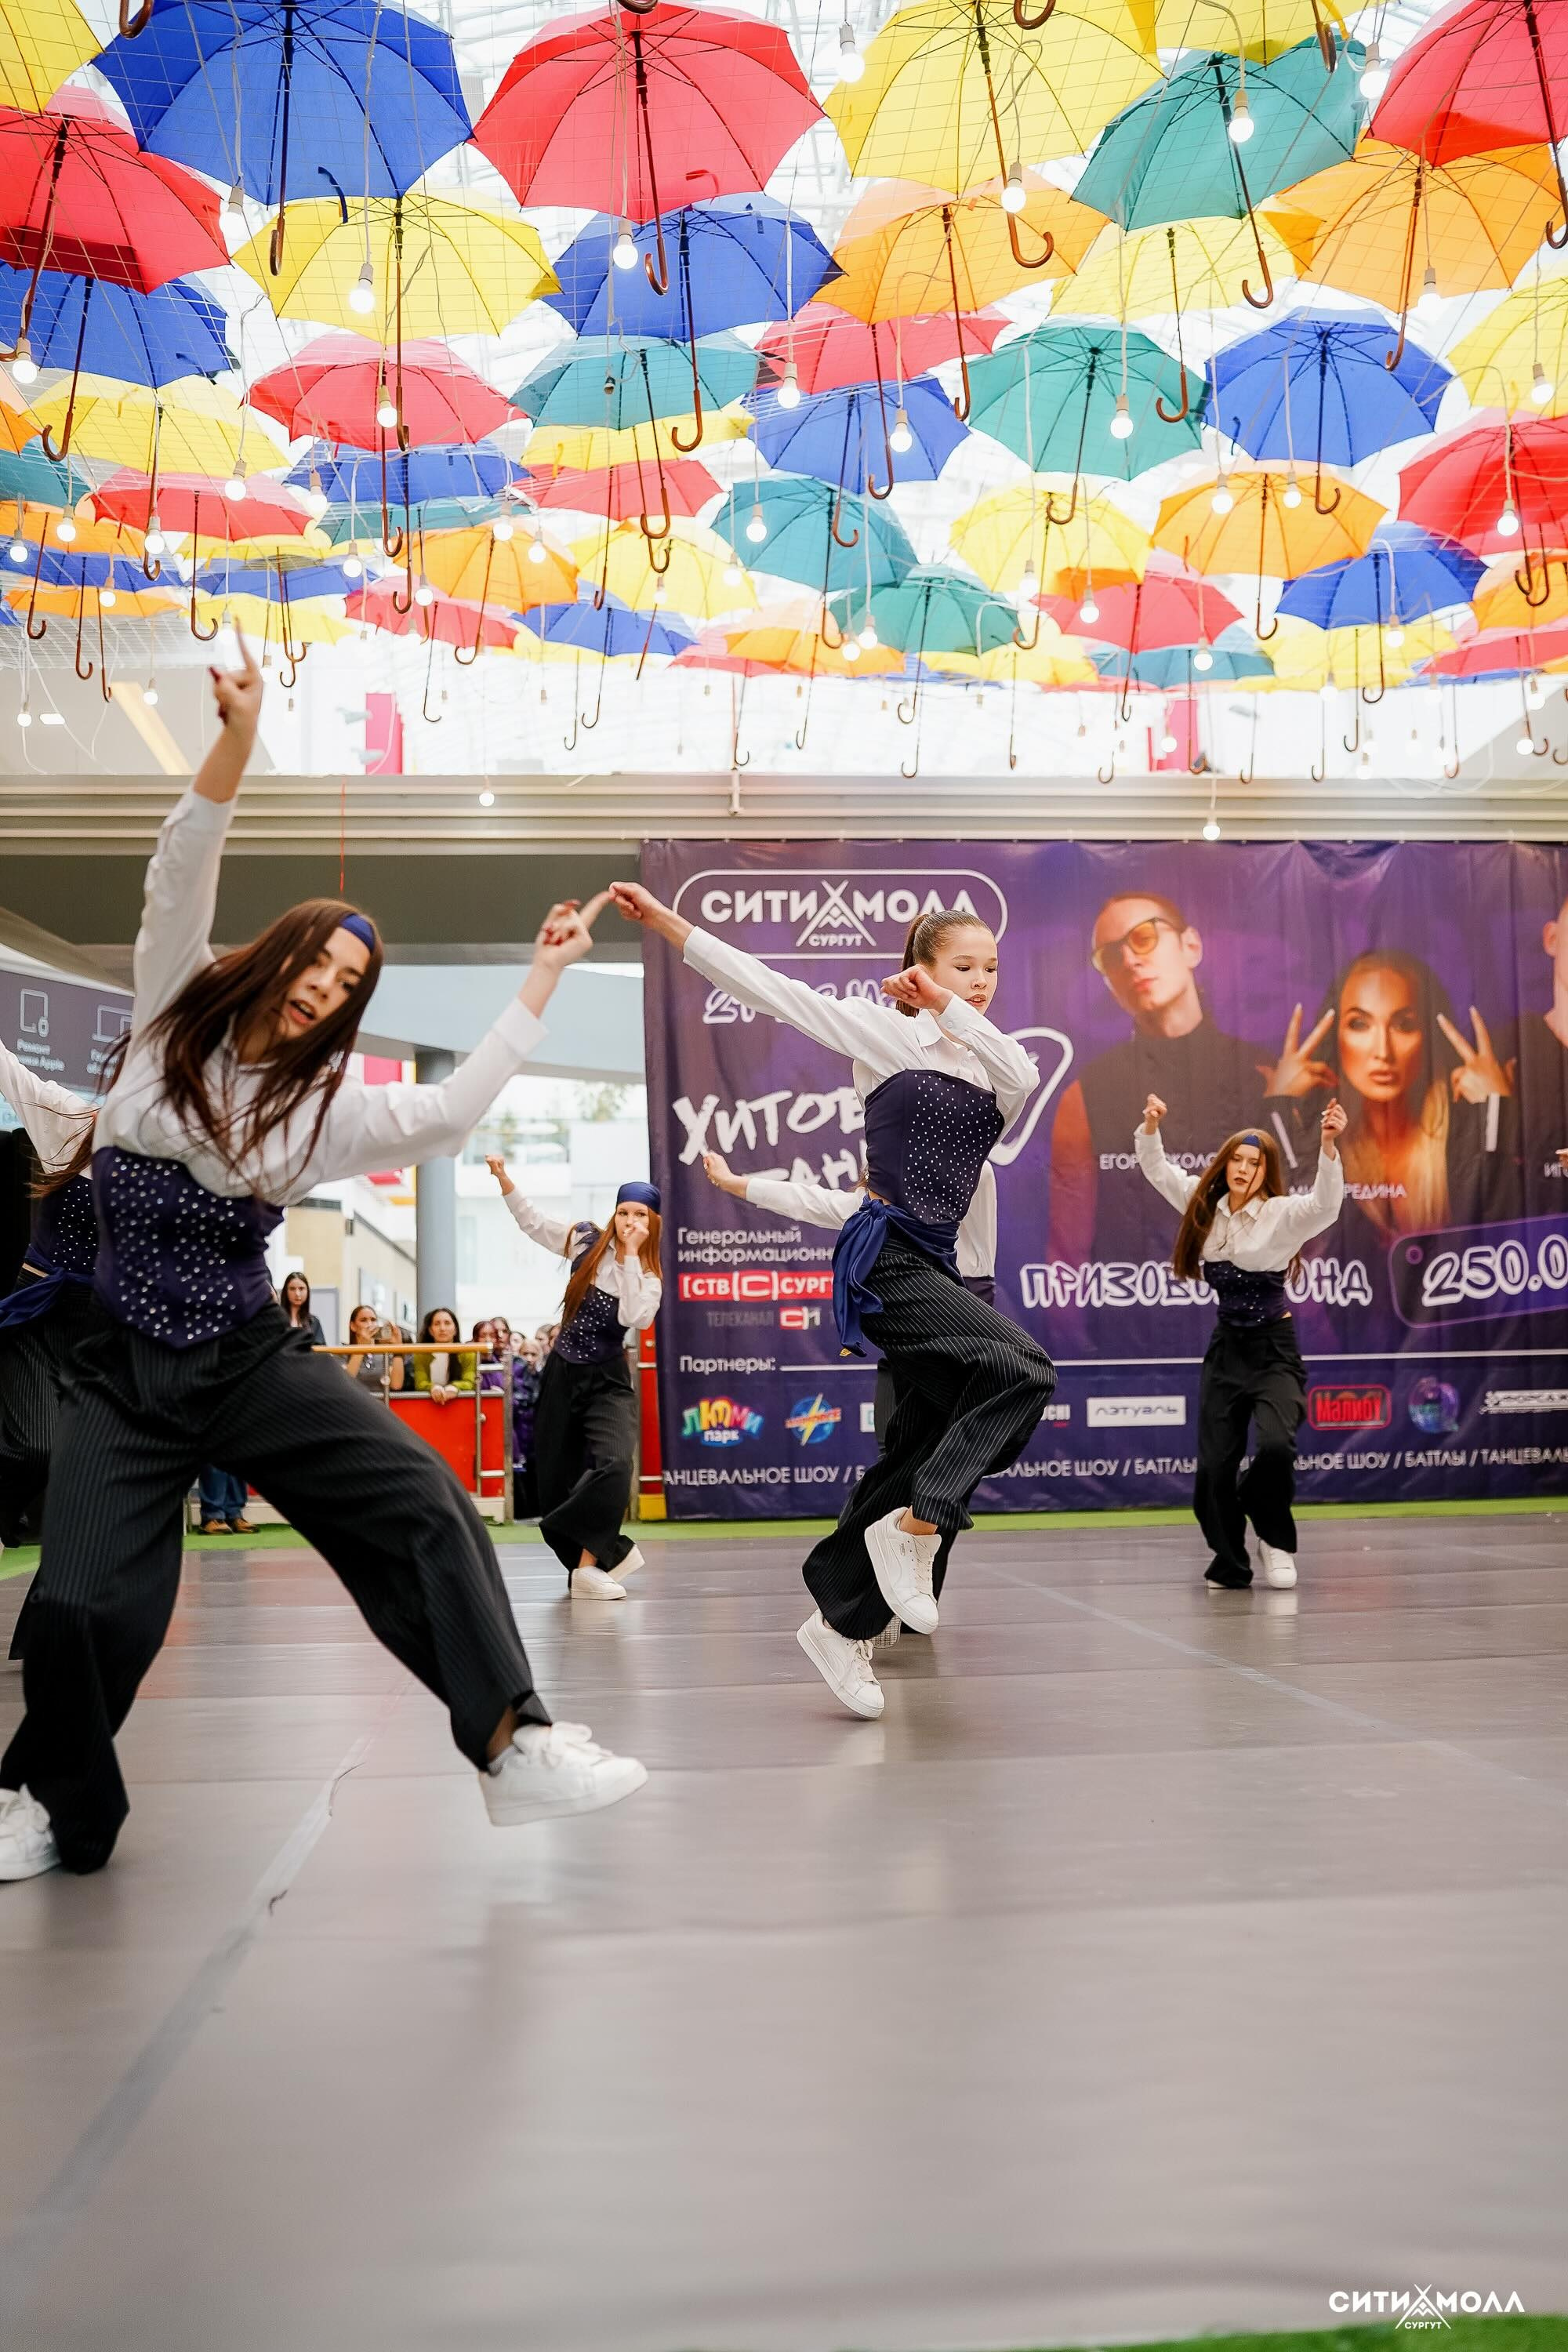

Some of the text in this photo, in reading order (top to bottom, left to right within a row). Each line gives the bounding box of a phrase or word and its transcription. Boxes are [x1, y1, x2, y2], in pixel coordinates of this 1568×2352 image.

[700, 889, 818, 924] СИТИ
[808, 934, 864, 947] СУРГУТ
[673, 1087, 866, 1166] ХИТОВ
[677, 1225, 802, 1247] Генеральный
[677, 1246, 836, 1266] информационн
[1283, 1258, 1373, 1307] ОНД
[680, 1356, 775, 1374] Партнеры:
[704, 1430, 739, 1443] парк
[1074, 1459, 1119, 1476] ШОУ
[1134, 1457, 1198, 1475] БАТТЛЫ
[1346, 1451, 1391, 1469] ШОУ
[1405, 1450, 1467, 1468] БАТТЛЫ
[663, 1468, 790, 1486] АНЦЕВАЛЬНОЕ
[794, 1466, 839, 1483] ШОУ
